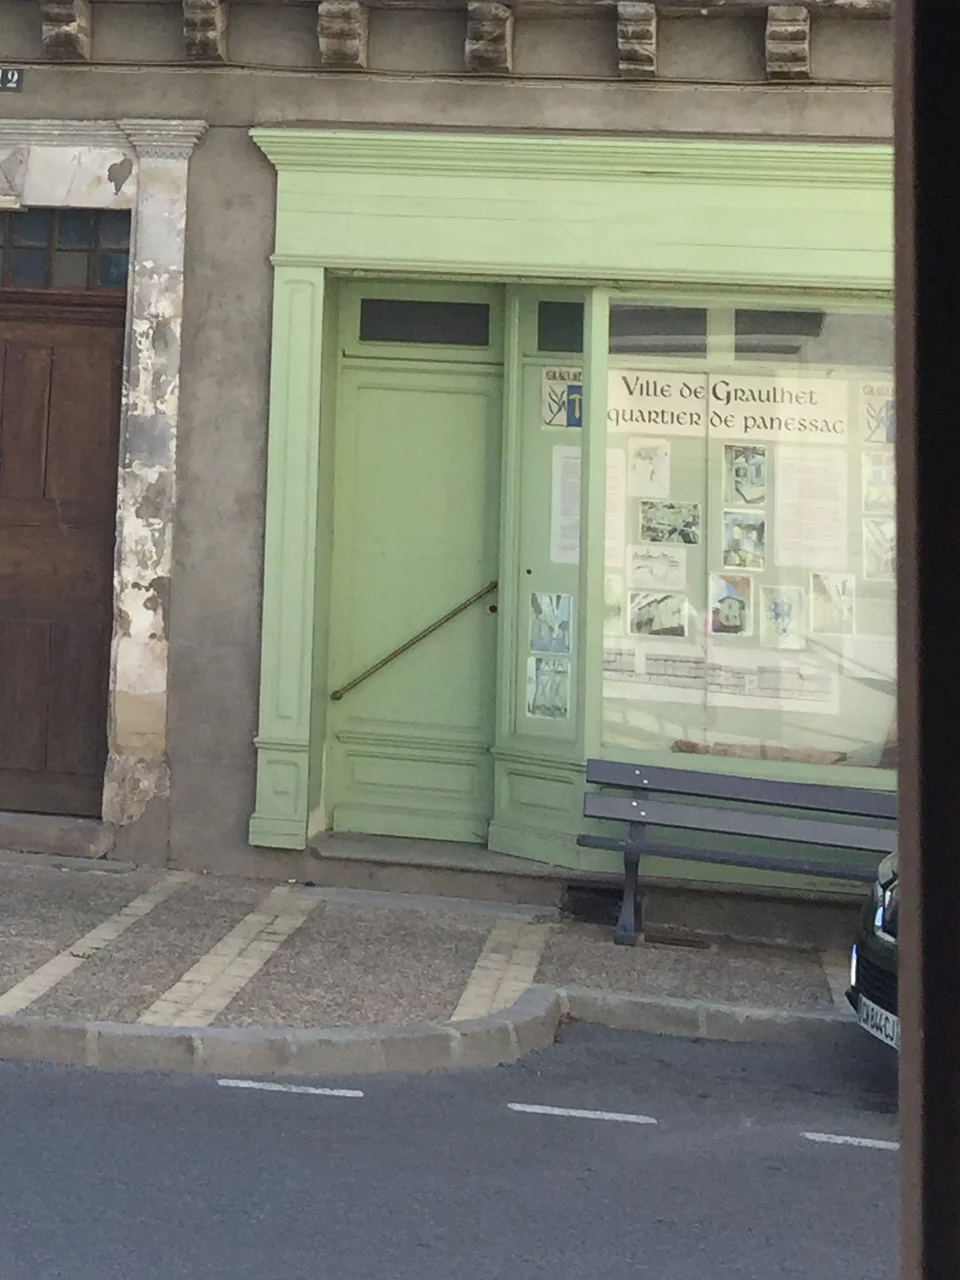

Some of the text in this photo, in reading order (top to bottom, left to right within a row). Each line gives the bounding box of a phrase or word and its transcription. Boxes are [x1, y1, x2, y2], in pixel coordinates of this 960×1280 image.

[622, 375, 818, 406] Ville de Graulhet
[607, 407, 845, 434] quartier de panessac
